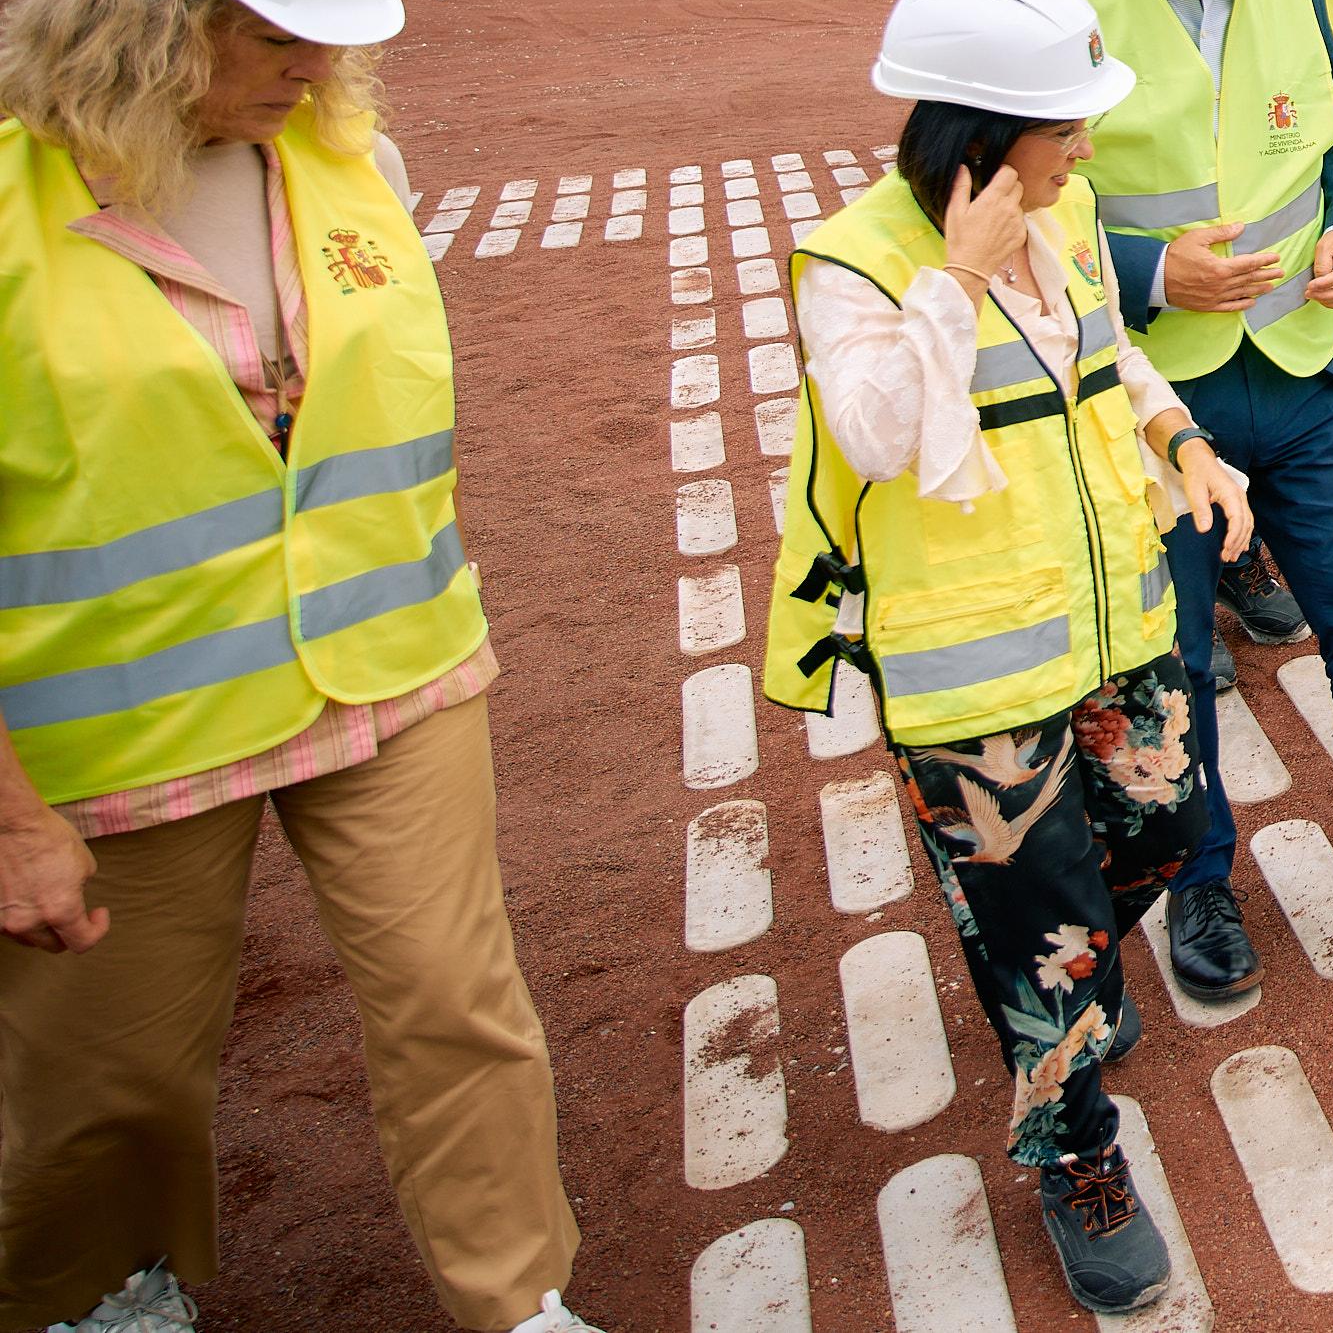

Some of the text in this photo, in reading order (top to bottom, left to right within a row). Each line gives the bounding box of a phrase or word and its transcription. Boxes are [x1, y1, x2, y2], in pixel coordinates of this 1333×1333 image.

[1270, 132, 1301, 140] MINISTERIO
[1264, 147, 1289, 155] AGENDA
[1290, 141, 1317, 153] URBANA
